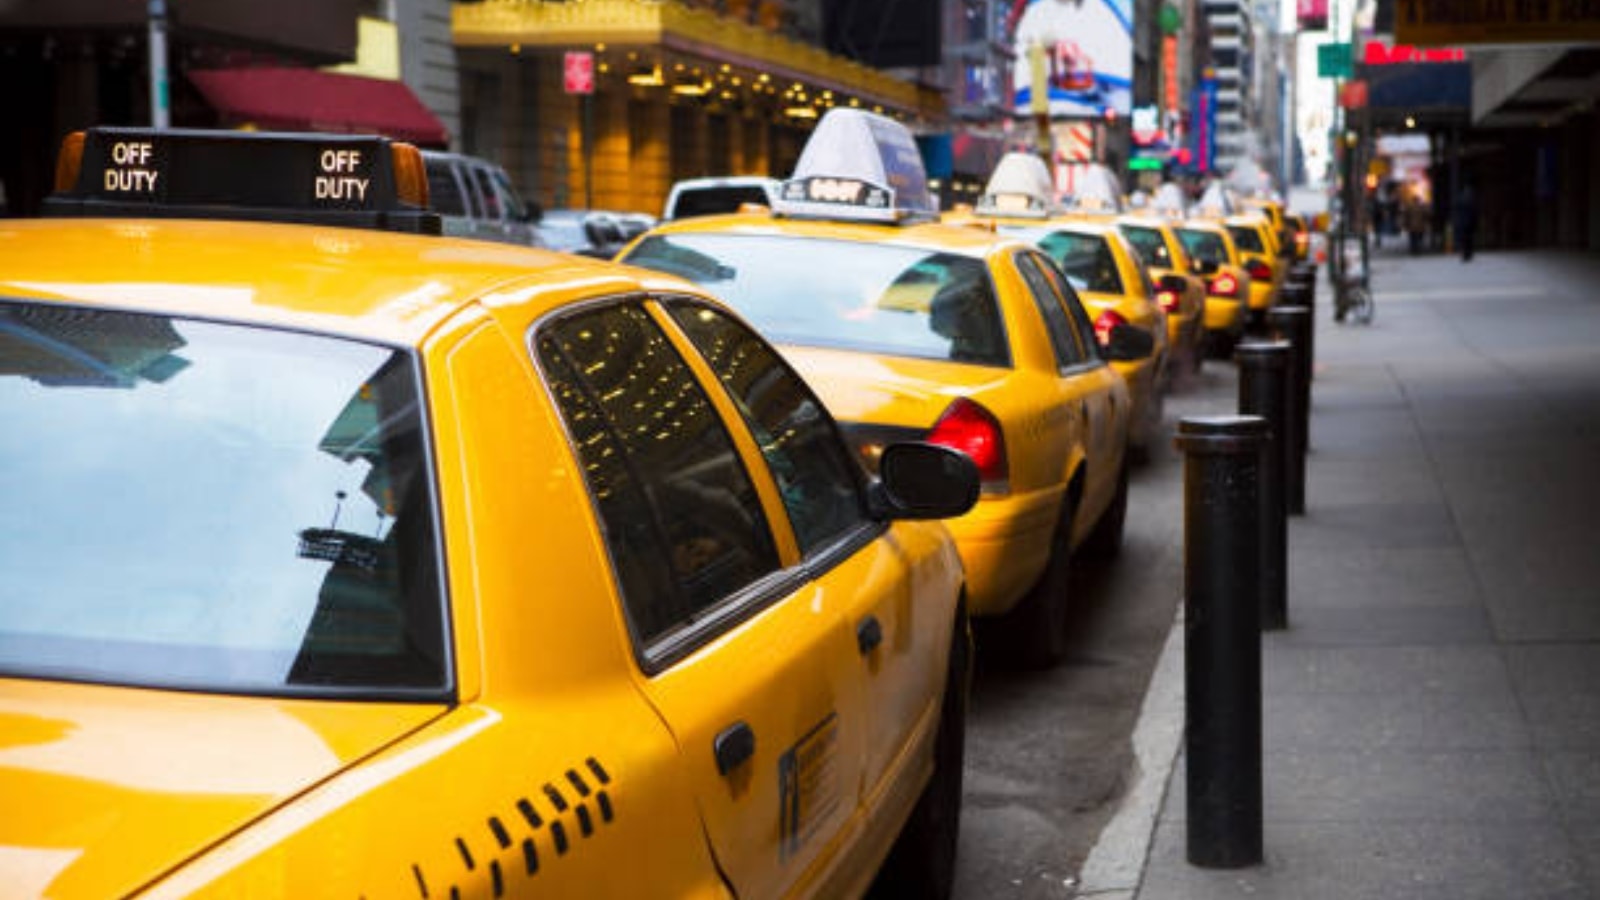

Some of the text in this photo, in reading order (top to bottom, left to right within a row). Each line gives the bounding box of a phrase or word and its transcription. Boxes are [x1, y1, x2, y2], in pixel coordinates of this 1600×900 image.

[112, 142, 152, 165] OFF
[321, 150, 361, 172] OFF
[104, 169, 158, 191] DUTY
[316, 177, 369, 201] DUTY
